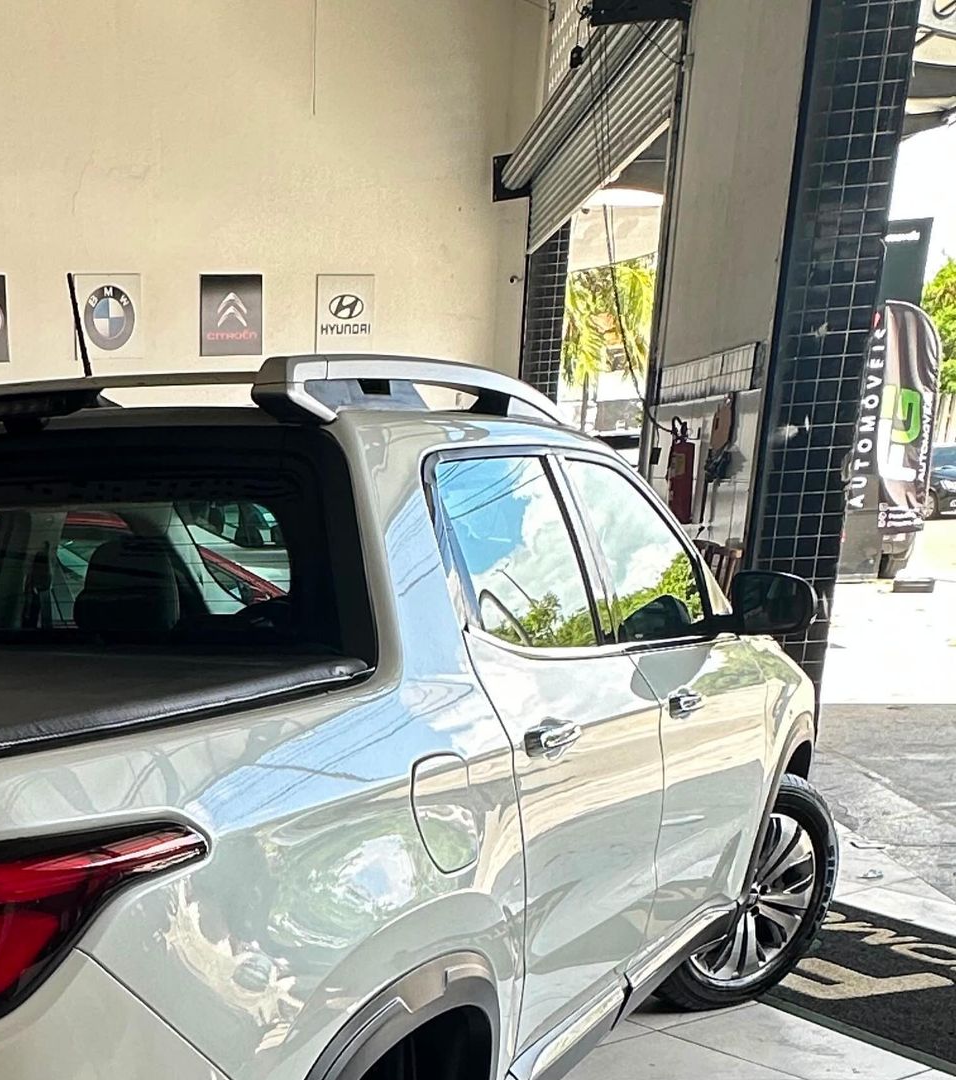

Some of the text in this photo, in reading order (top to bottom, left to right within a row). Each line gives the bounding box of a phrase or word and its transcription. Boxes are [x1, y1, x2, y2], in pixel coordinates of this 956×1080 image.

[88, 286, 130, 308] BMW
[320, 322, 371, 335] HYUNDAI
[876, 384, 921, 481] FG
